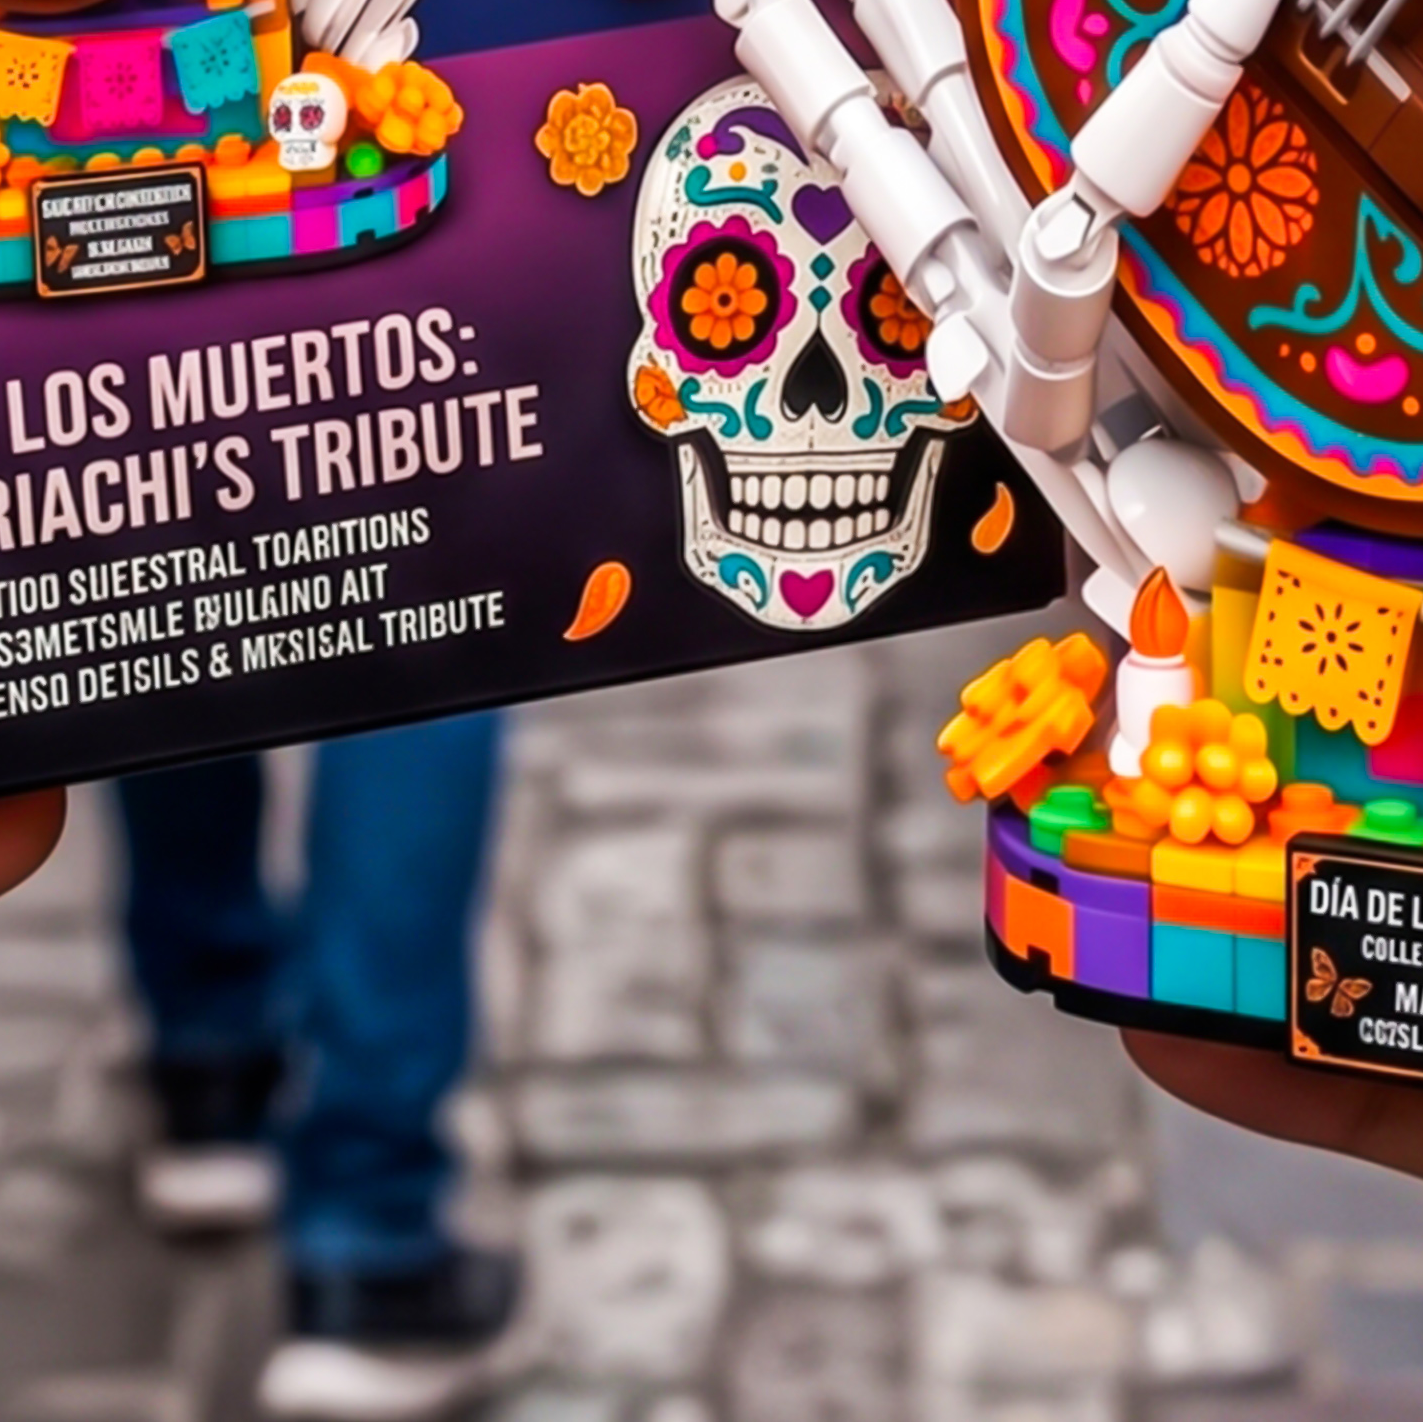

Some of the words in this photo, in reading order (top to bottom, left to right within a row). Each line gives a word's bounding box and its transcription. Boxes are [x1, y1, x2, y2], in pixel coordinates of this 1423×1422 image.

[6, 363, 130, 454] LOS
[149, 307, 478, 430] MUERTOS:
[270, 384, 543, 501] TRIBUTE
[341, 563, 388, 606] AIT
[209, 642, 232, 679] &
[378, 591, 505, 647] TRIBUTE
[1309, 875, 1360, 920] DÍA
[1366, 887, 1405, 927] DE
